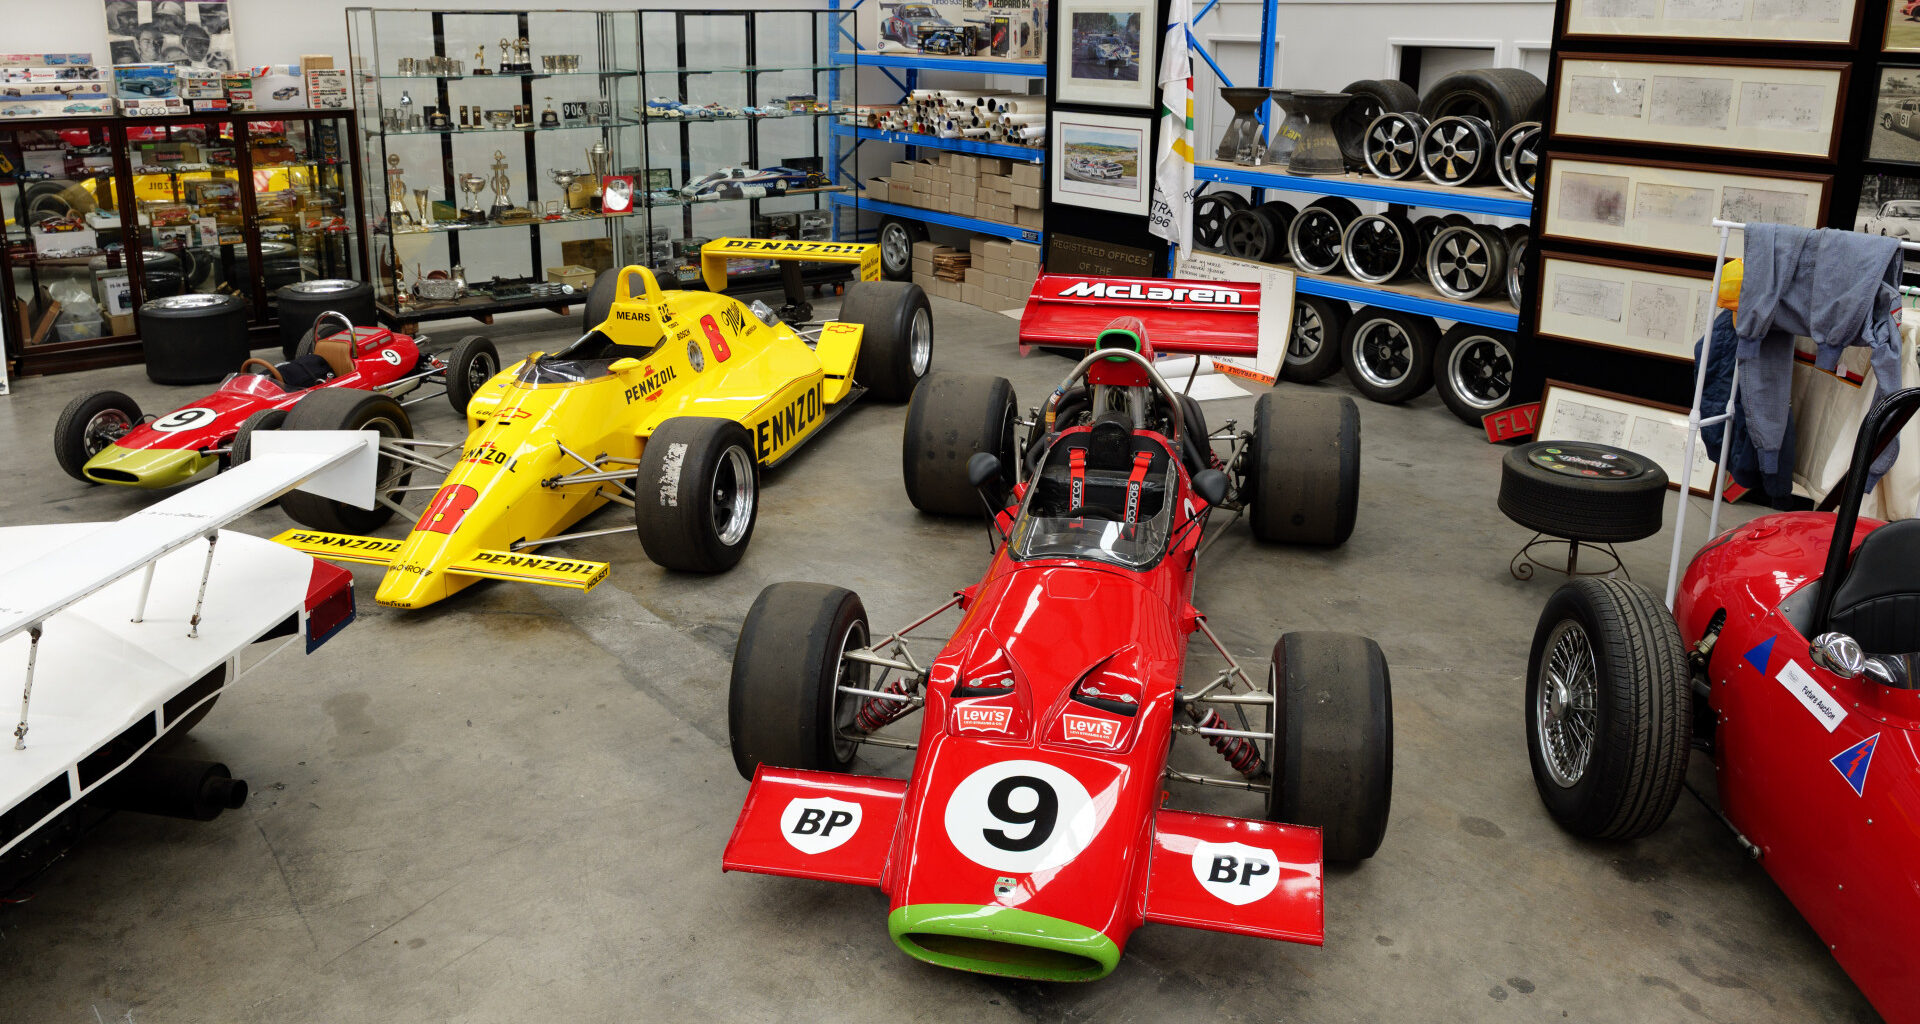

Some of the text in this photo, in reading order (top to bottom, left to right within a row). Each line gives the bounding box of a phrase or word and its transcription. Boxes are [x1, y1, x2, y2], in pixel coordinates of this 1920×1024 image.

[564, 104, 583, 116] 906
[1052, 239, 1148, 266] REGISTERED OFFICES
[1079, 262, 1112, 275] OF THE
[1058, 281, 1241, 304] McLaren
[616, 311, 651, 322] MEARS
[699, 313, 732, 363] 8
[386, 350, 398, 364] 9
[624, 365, 677, 405] PENNZOIL
[160, 410, 206, 428] 9
[747, 380, 825, 460] ENNZOI
[414, 483, 479, 535] 8
[1128, 483, 1140, 524] sparco
[286, 533, 401, 553] PENNZOIL
[471, 552, 596, 576] PENNZOIL
[586, 568, 610, 590] HOLSET
[1801, 685, 1836, 721] Future Auction
[792, 808, 854, 837] BP
[982, 776, 1059, 852] 9
[1207, 855, 1271, 887] BP
